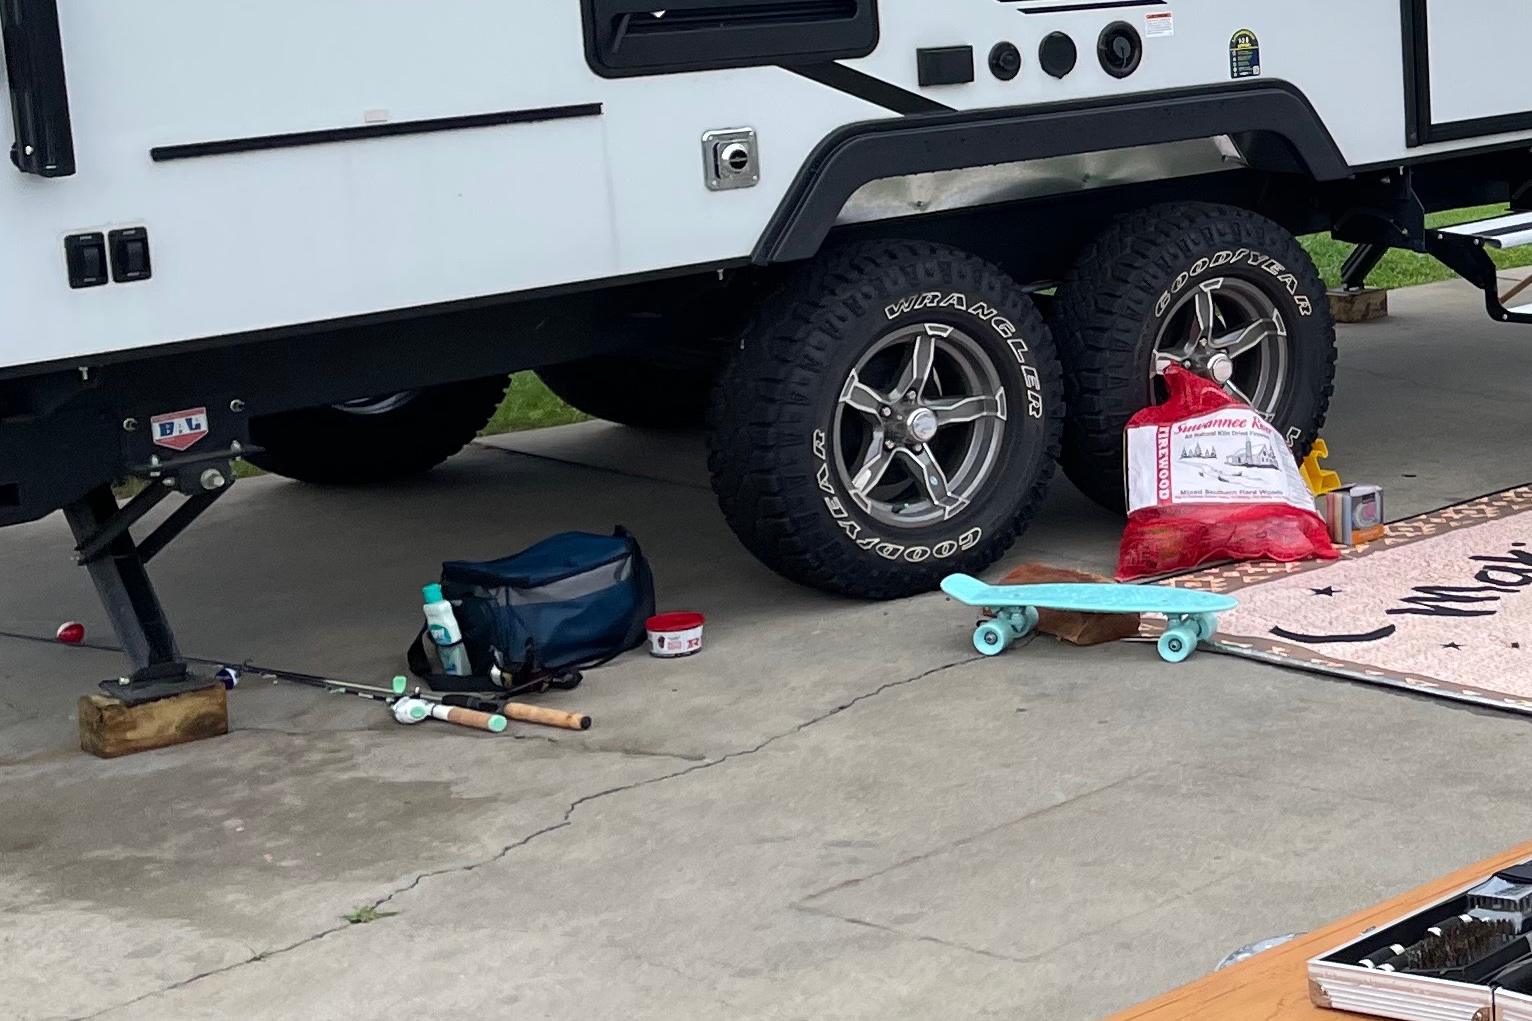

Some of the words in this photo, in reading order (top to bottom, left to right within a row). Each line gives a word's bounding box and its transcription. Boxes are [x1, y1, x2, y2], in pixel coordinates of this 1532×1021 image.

[1155, 248, 1313, 318] GOODYEAR
[884, 292, 1043, 419] WRANGLER
[813, 429, 982, 563] GOODYEAR
